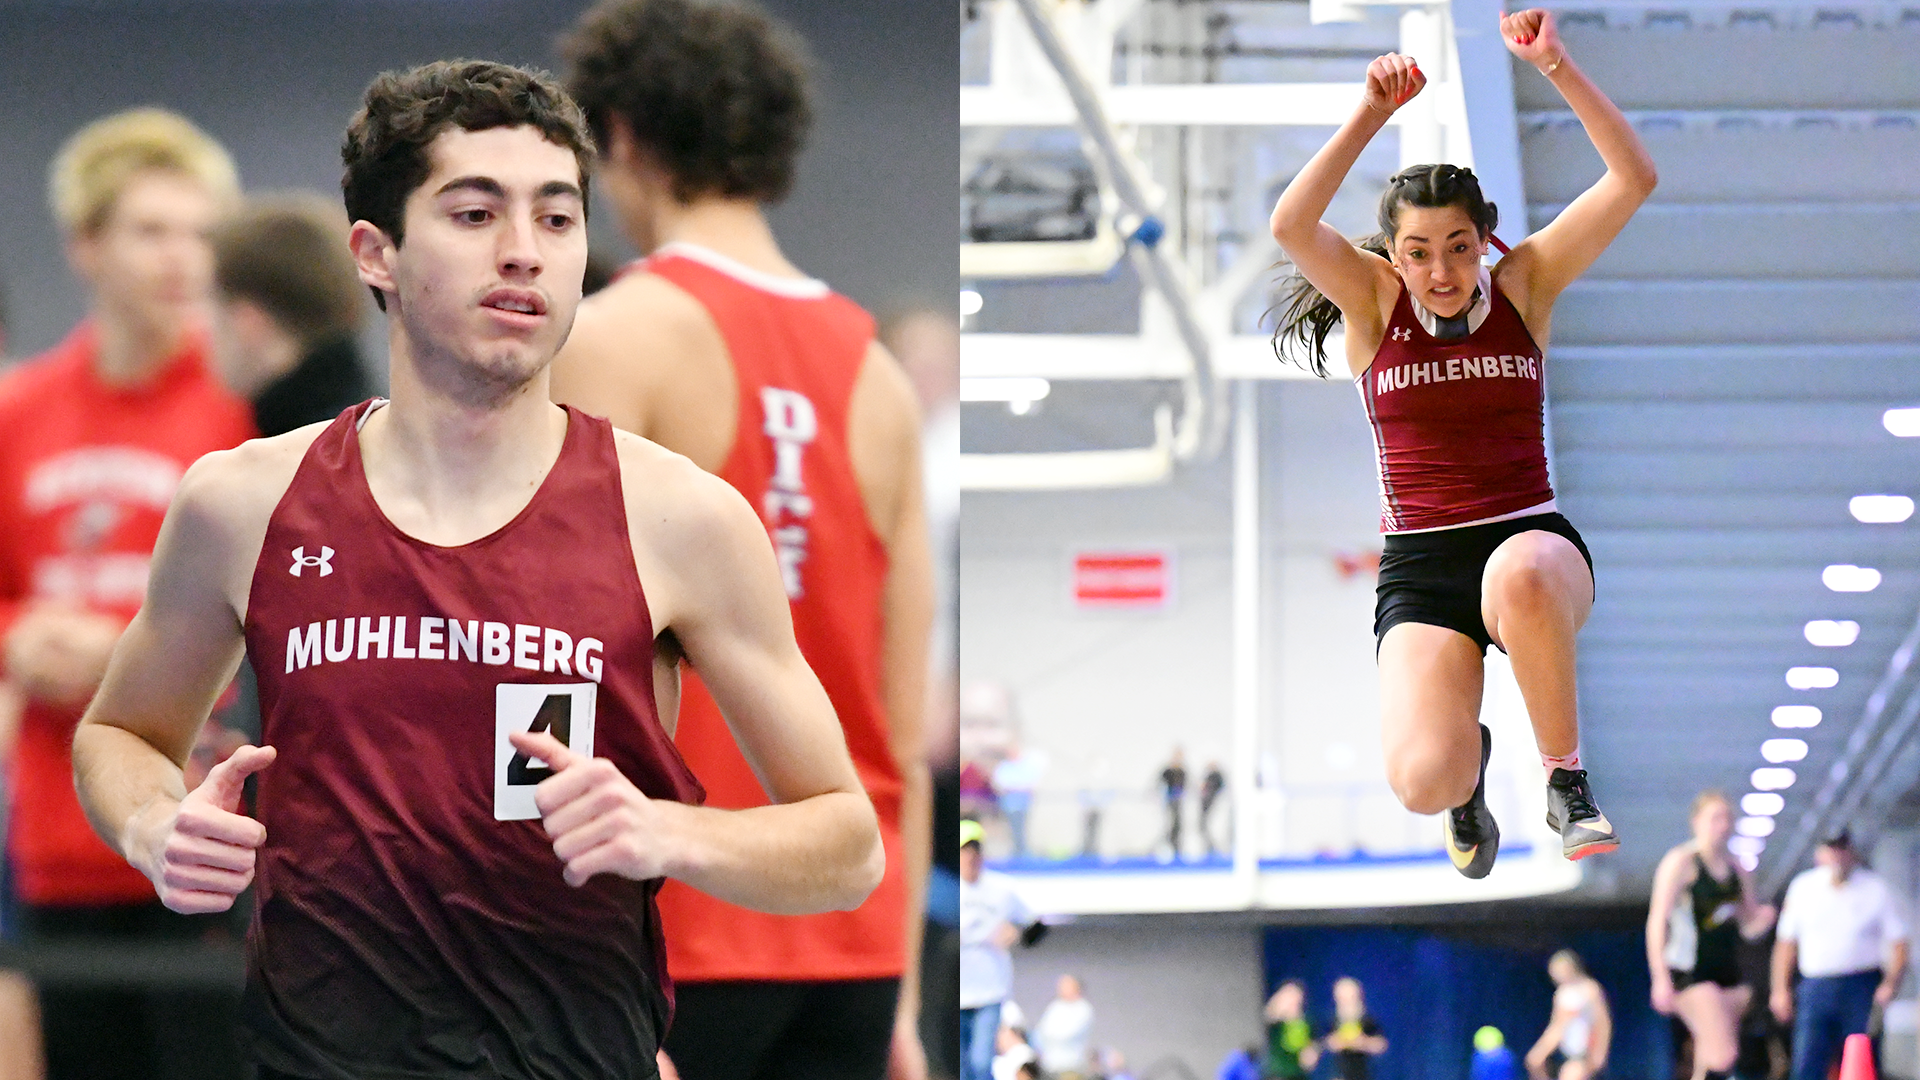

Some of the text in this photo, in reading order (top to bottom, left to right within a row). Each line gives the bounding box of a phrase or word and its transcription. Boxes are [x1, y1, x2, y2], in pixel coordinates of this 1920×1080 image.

[1377, 354, 1537, 396] MUHLENBERG
[285, 616, 604, 683] MUHLENBERG
[507, 693, 572, 786] 4
